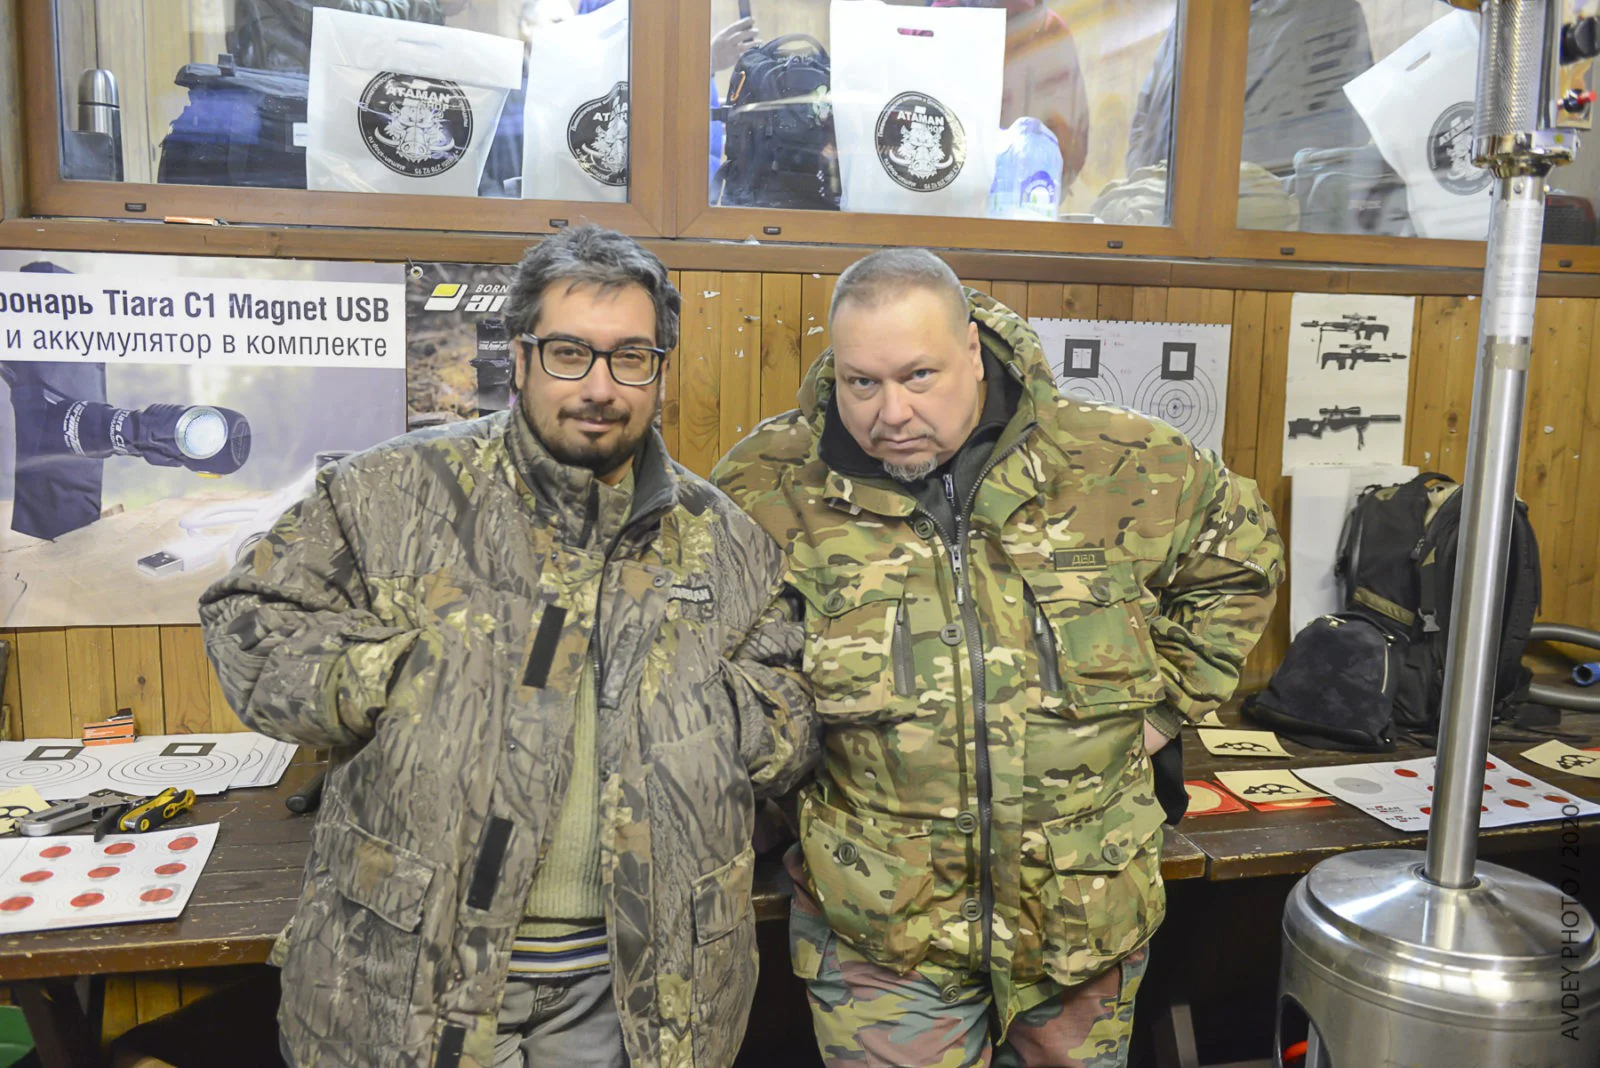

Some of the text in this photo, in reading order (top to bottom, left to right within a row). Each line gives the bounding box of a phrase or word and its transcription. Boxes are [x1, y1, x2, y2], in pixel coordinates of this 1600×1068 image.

[386, 86, 450, 104] ATAMAN
[897, 111, 944, 126] ATAMAN
[475, 284, 509, 293] BORN
[102, 289, 174, 317] Tiara
[184, 291, 215, 318] C1
[229, 293, 327, 326] Magnet
[336, 296, 389, 322] USB
[6, 329, 387, 359] и аккумулятор в комплекте
